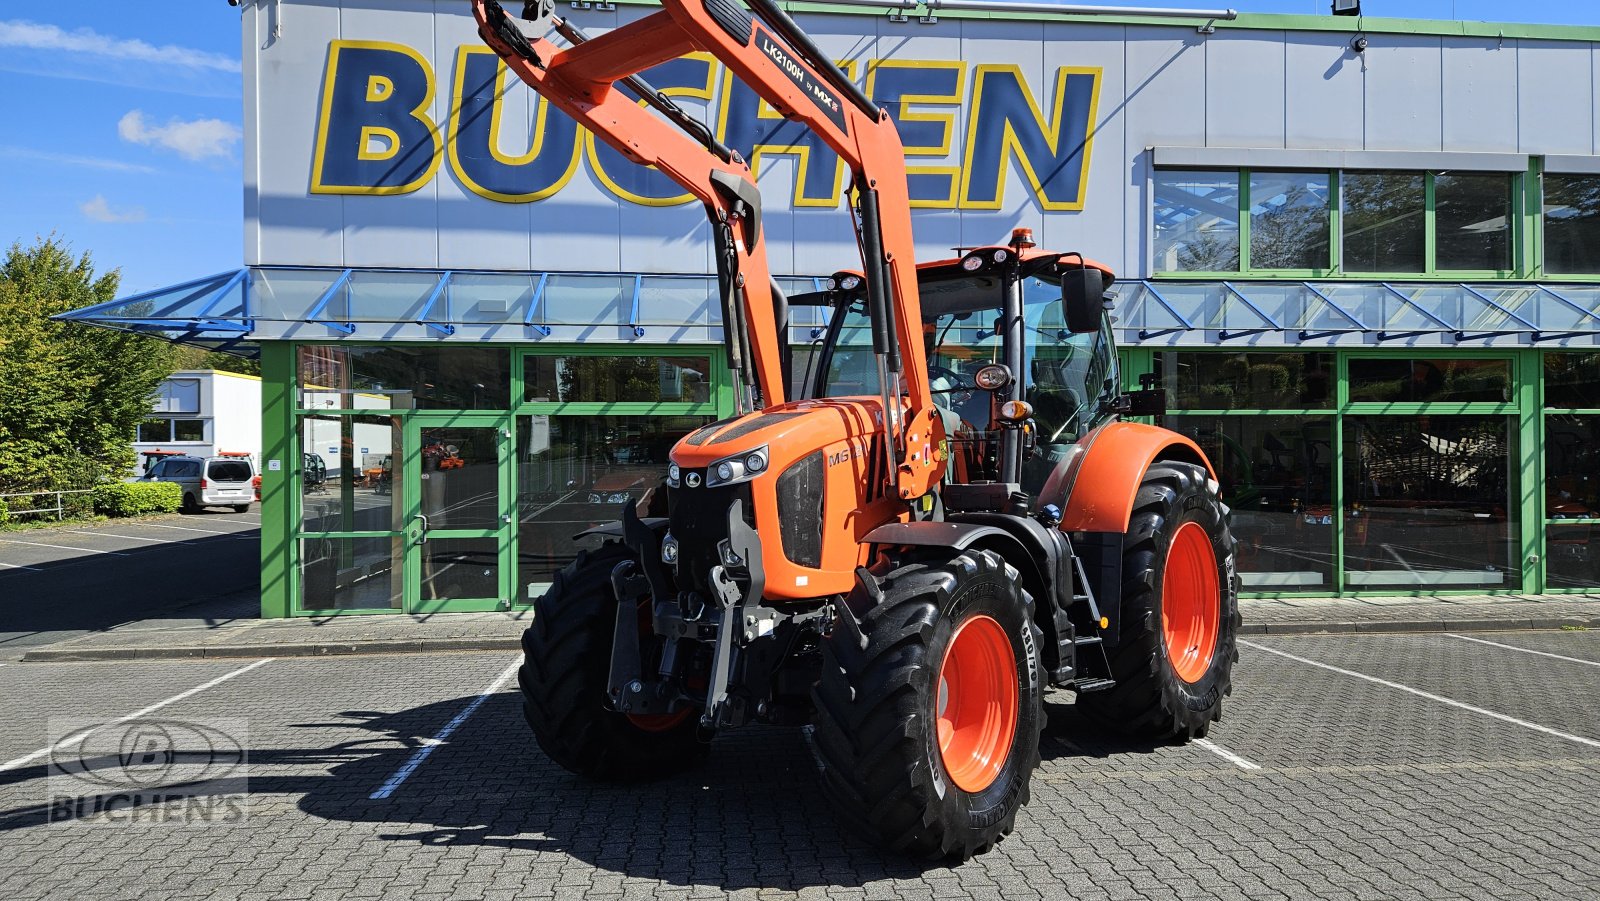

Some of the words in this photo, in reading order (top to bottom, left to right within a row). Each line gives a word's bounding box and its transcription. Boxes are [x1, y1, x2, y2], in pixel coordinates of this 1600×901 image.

[763, 38, 804, 83] LK2100H
[806, 81, 814, 92] by
[310, 39, 1103, 211] BUCHEN
